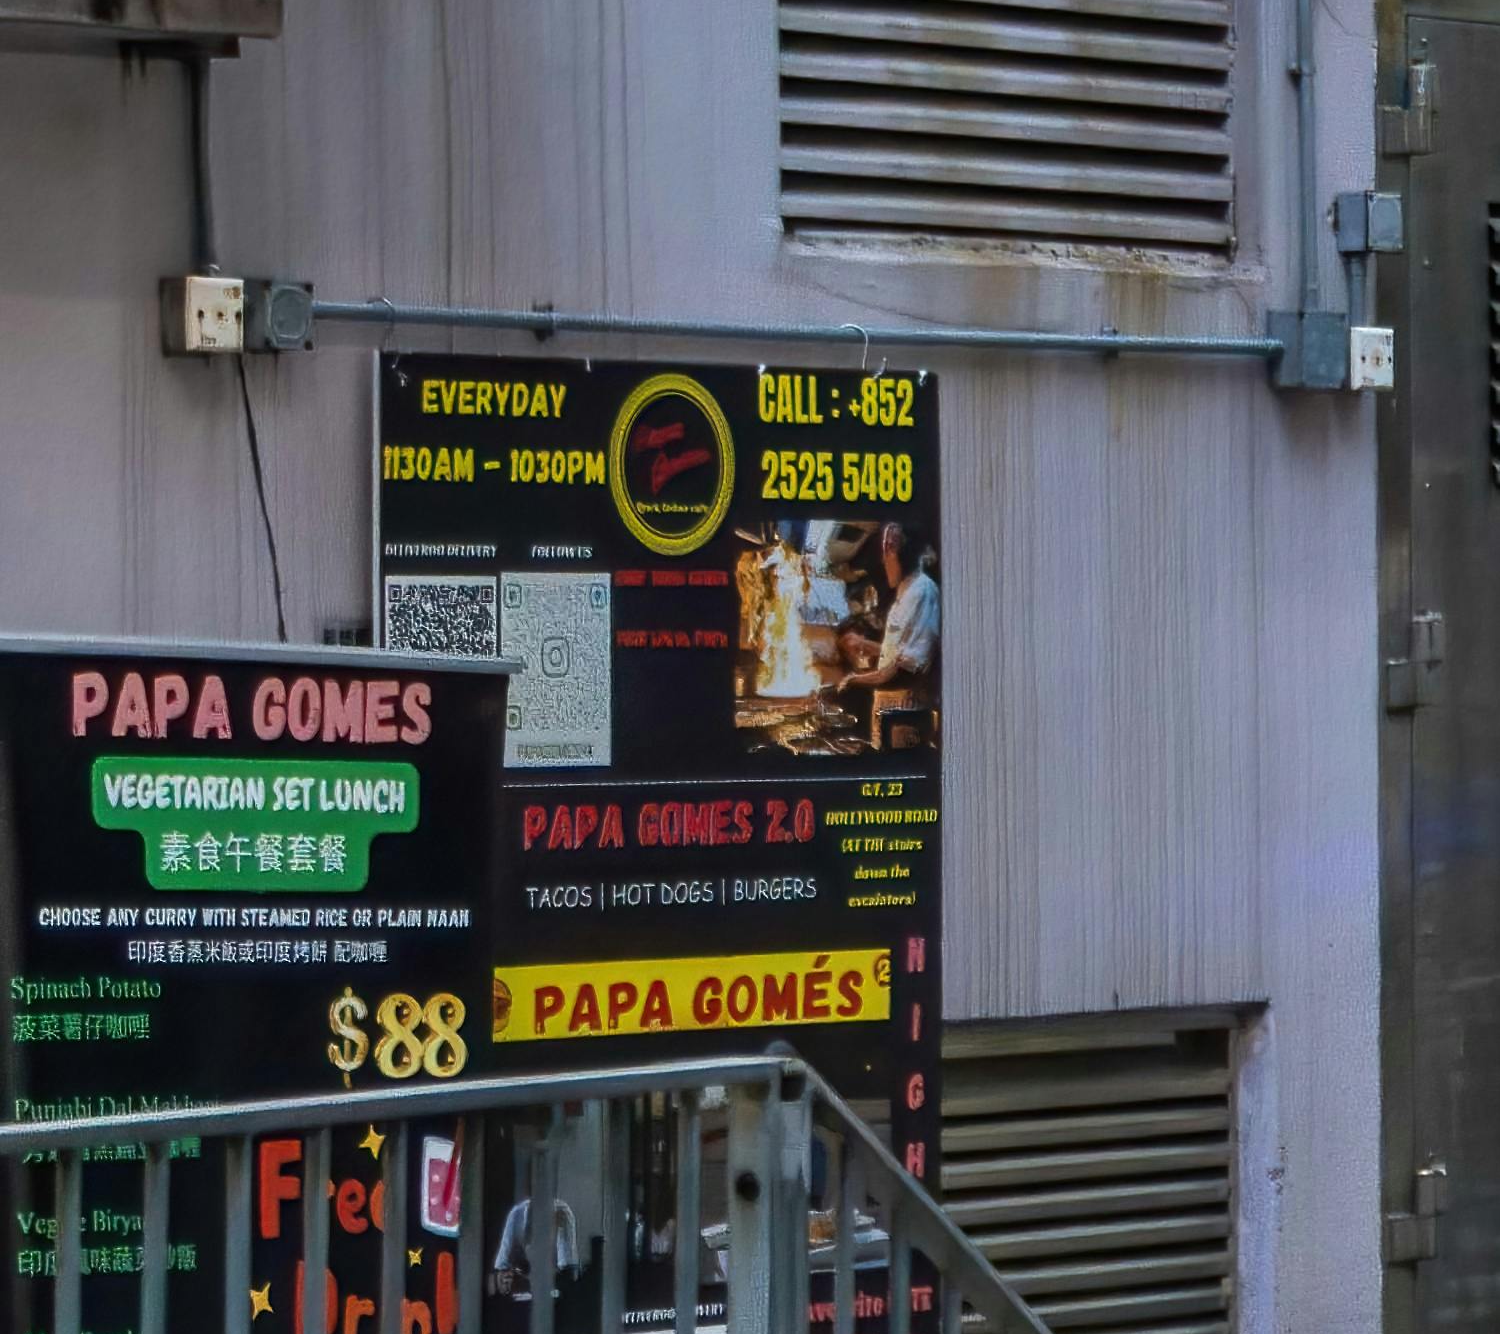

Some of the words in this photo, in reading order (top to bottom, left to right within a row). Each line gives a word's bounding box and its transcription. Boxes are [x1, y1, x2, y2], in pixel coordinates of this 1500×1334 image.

[422, 379, 566, 418] EVERYDAY
[759, 373, 823, 424] CALL
[849, 377, 914, 427] +852
[383, 445, 474, 482] 1130AM
[510, 448, 606, 485] 1030PM
[761, 449, 834, 500] 2525
[842, 452, 912, 503] 5488
[73, 672, 233, 740] PAPA
[253, 677, 432, 745] GOMES
[104, 774, 265, 811] VEGETARIAN
[273, 777, 314, 812] SET
[320, 778, 406, 814] LUNCH
[524, 804, 624, 851] PAPA
[638, 800, 753, 847] GOMES
[766, 799, 816, 844] 2.0
[160, 831, 348, 873] 素食午餐套餐
[526, 887, 592, 910] TACOS
[613, 883, 660, 906] HOT
[661, 880, 715, 904] DOGS
[734, 878, 817, 902] BURGERS
[38, 907, 101, 928] CHOOSE
[107, 907, 140, 928] ANY
[145, 907, 197, 928] CURRY
[202, 907, 236, 927] WITH
[240, 907, 310, 928] STEAMED
[316, 907, 347, 927] RICE
[353, 908, 372, 927] OR
[377, 907, 422, 928] PLAIN
[427, 908, 471, 928] NAAN
[10, 976, 91, 1005] Spinach
[99, 977, 162, 999] Potato
[534, 979, 673, 1035] PAPA
[692, 955, 864, 1024] GOMÉS
[327, 985, 469, 1087] $88
[17, 1210, 87, 1239] Vege
